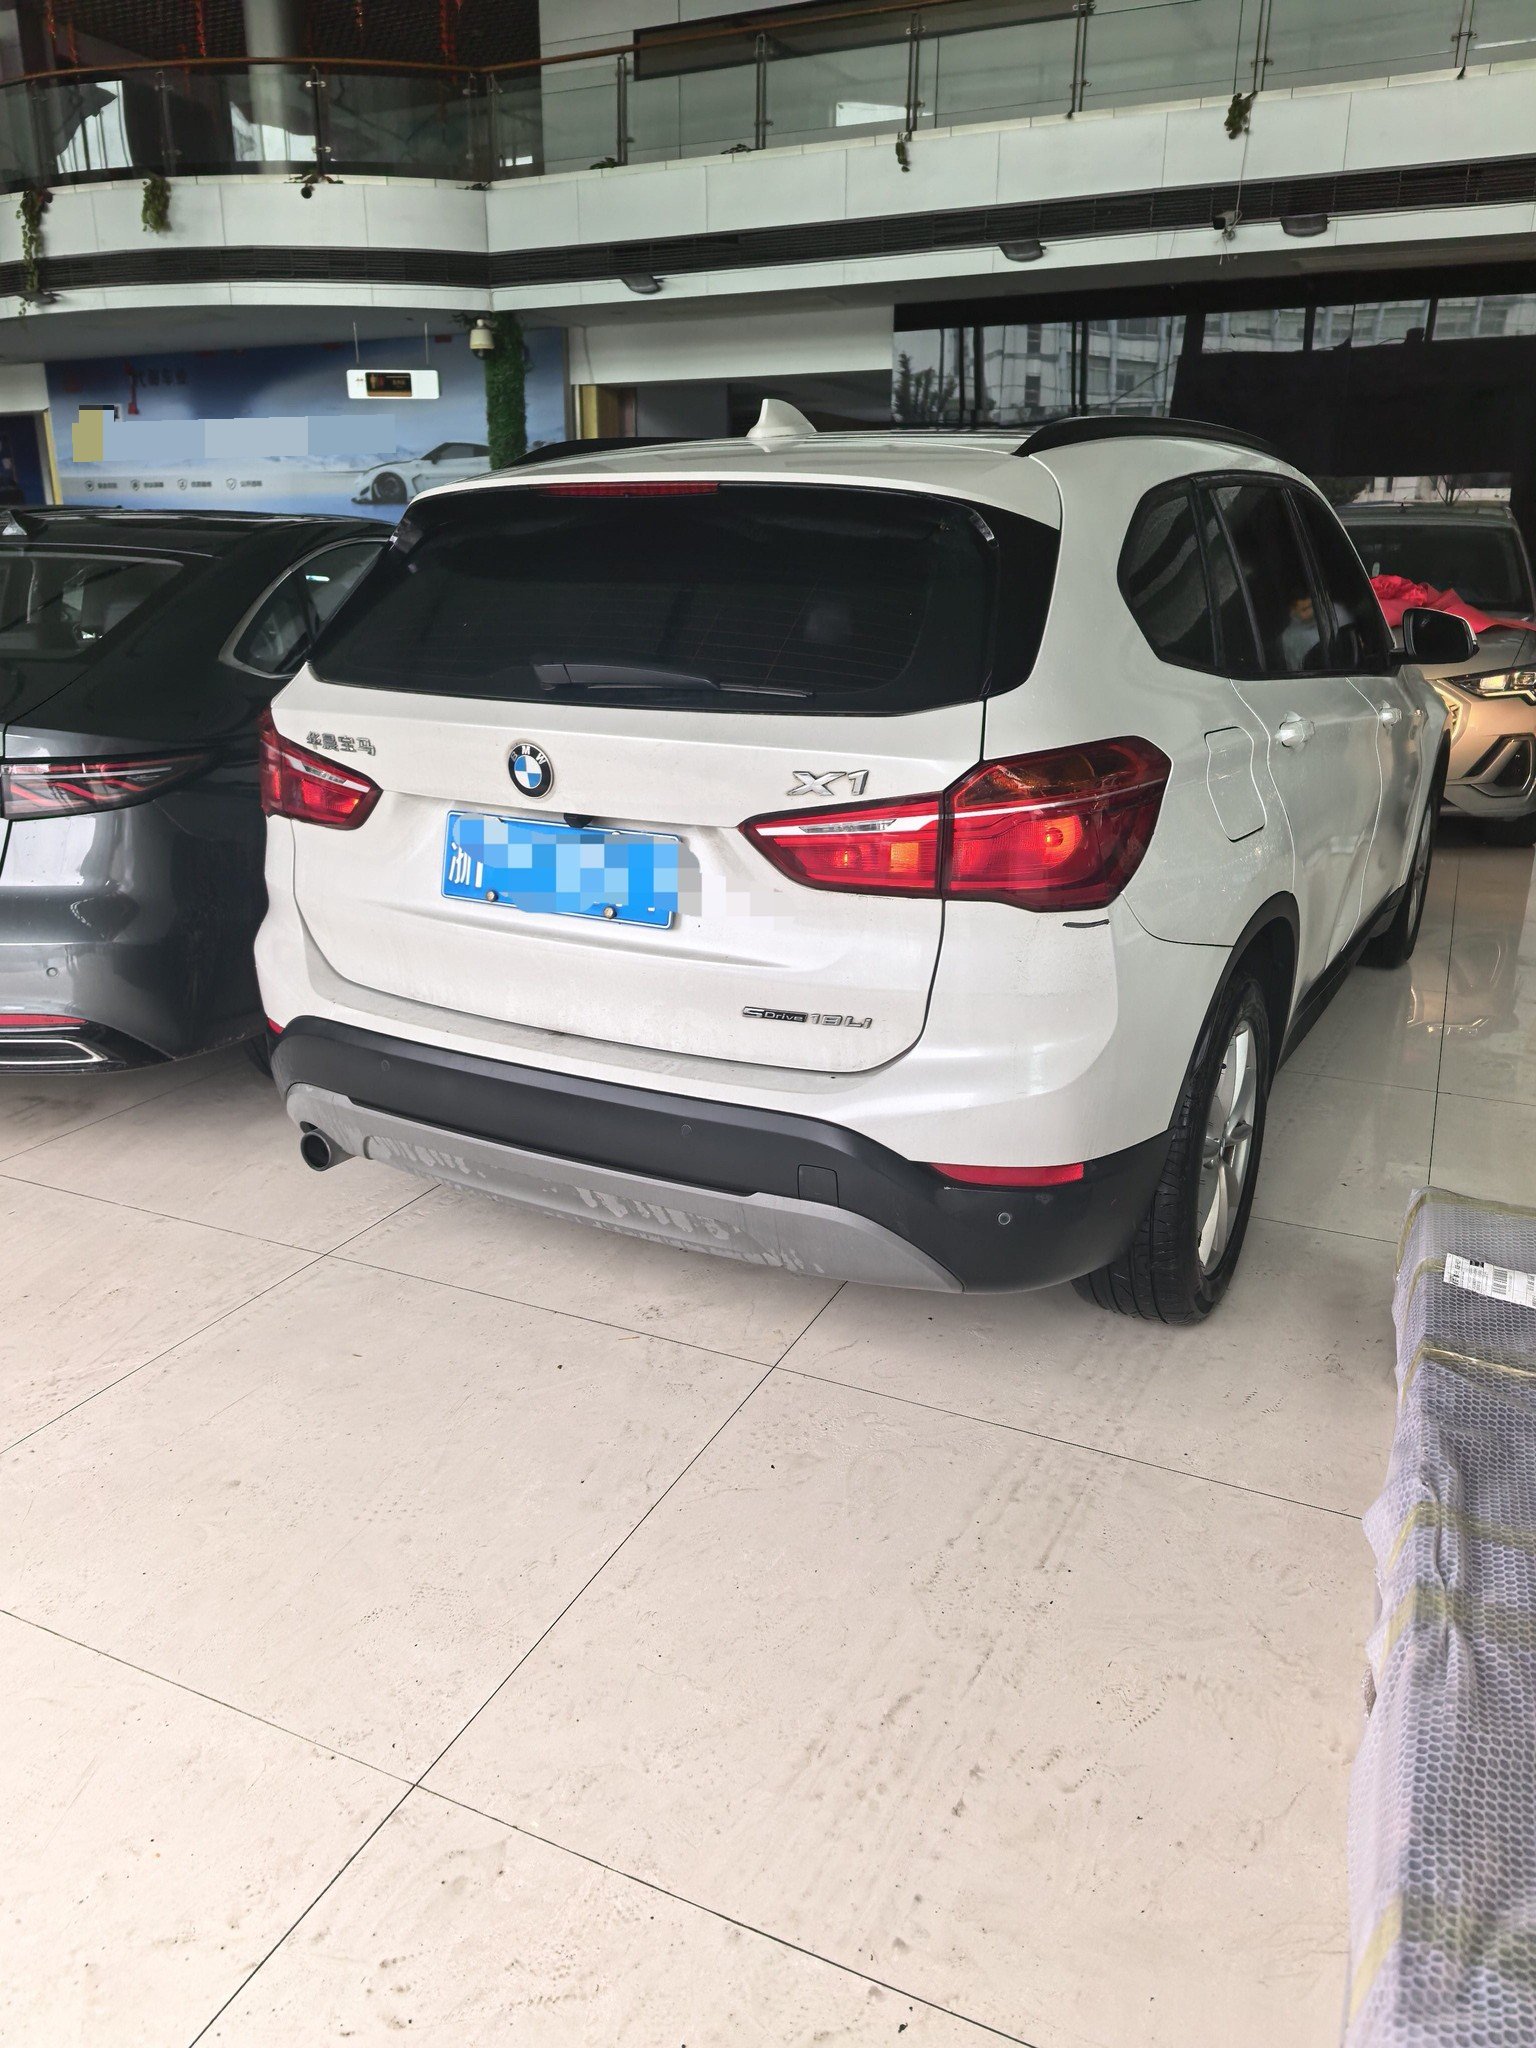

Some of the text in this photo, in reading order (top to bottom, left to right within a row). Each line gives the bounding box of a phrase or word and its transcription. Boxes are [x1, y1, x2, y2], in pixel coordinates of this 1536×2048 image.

[306, 731, 376, 756] 华晨宝马
[511, 745, 547, 765] BMW
[786, 769, 869, 796] X1
